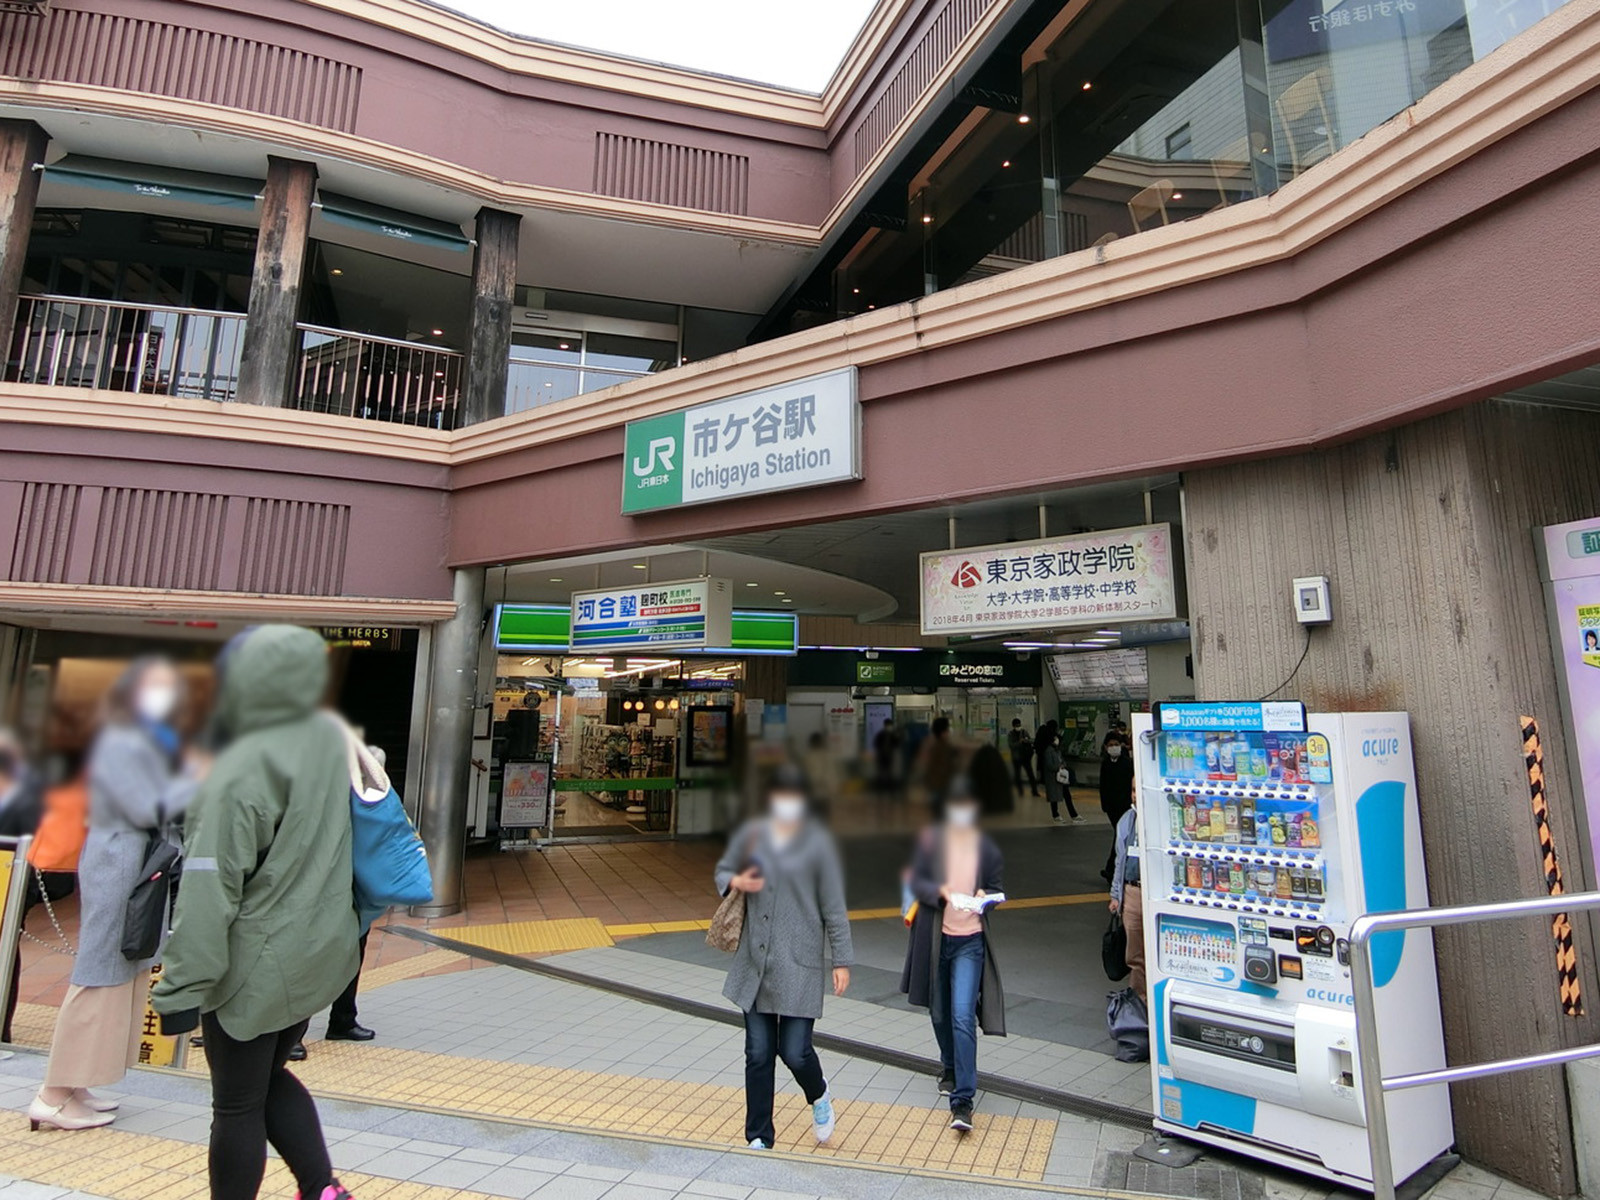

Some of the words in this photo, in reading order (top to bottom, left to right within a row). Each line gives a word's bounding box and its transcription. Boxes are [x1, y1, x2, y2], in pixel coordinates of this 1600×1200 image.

[633, 436, 676, 477] JR
[691, 461, 760, 490] Ichigaya
[765, 447, 831, 476] Station
[637, 474, 670, 489] JR東日本
[986, 543, 1135, 585] 東京家政学院
[578, 595, 637, 621] 河合塾
[933, 613, 973, 625] 2018年4月
[323, 628, 343, 639] THE
[348, 628, 389, 639] HERBS
[950, 665, 997, 676] みどりの窓口
[1362, 737, 1399, 758] acure
[1306, 987, 1354, 1006] acure
